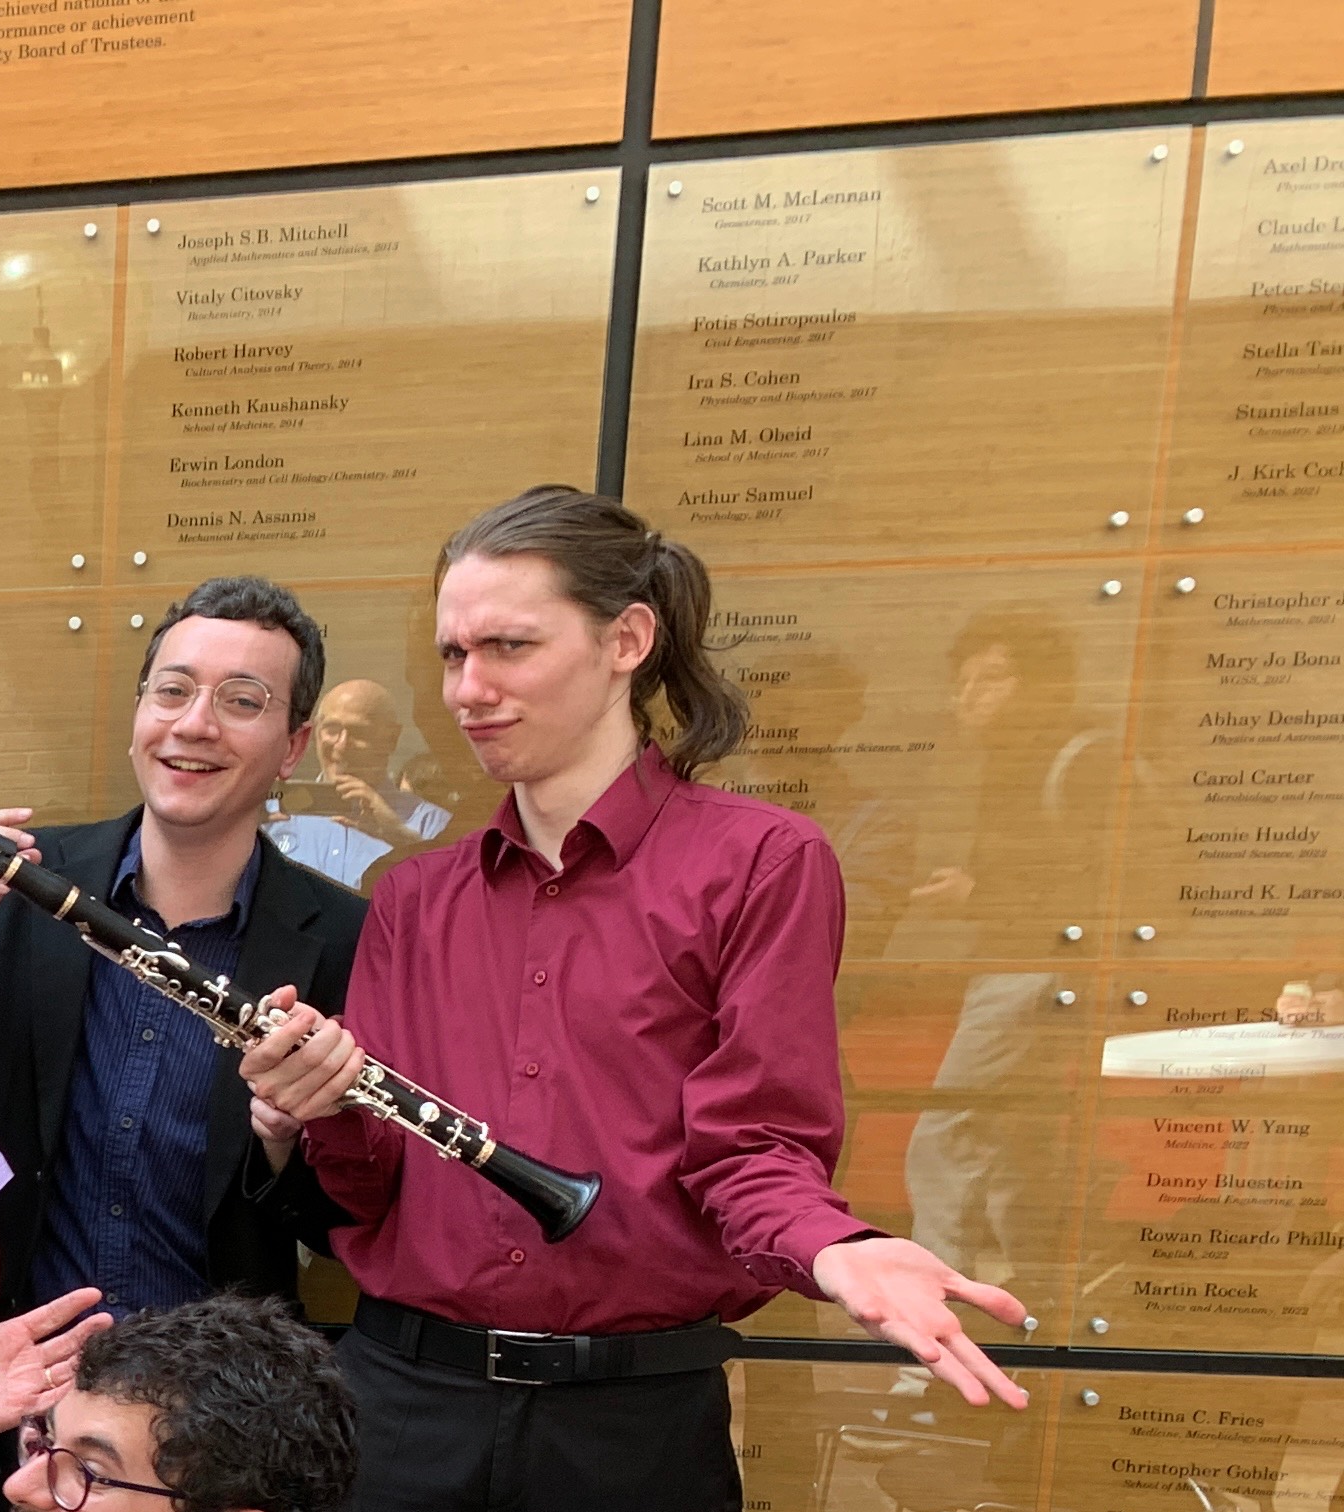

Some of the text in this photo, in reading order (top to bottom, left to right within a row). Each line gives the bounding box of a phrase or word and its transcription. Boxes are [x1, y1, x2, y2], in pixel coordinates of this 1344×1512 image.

[70, 21, 87, 32] or
[92, 9, 195, 30] achievement
[19, 41, 66, 59] Board
[71, 39, 88, 55] of
[91, 37, 166, 53] Trustees.
[692, 309, 857, 332] Fotis Sotiropoulos
[173, 344, 293, 363] Robert Harvey
[172, 395, 348, 418] Kenneth Kaushansky
[170, 454, 284, 473] Erwin London
[678, 485, 813, 506] Arthur Samuel
[726, 612, 797, 627] Hannun
[722, 779, 808, 794] Gurevitch
[1193, 770, 1314, 787] Carol Carter
[1154, 1118, 1222, 1133] Vincent
[1263, 1120, 1310, 1137] Yang
[1147, 1173, 1302, 1190] Danny Bluestein
[1134, 1281, 1257, 1298] Martin Rocek
[1118, 1406, 1184, 1423] Bettina
[1219, 1411, 1264, 1427] Fries
[1112, 1459, 1288, 1481] Christopher Gobler
